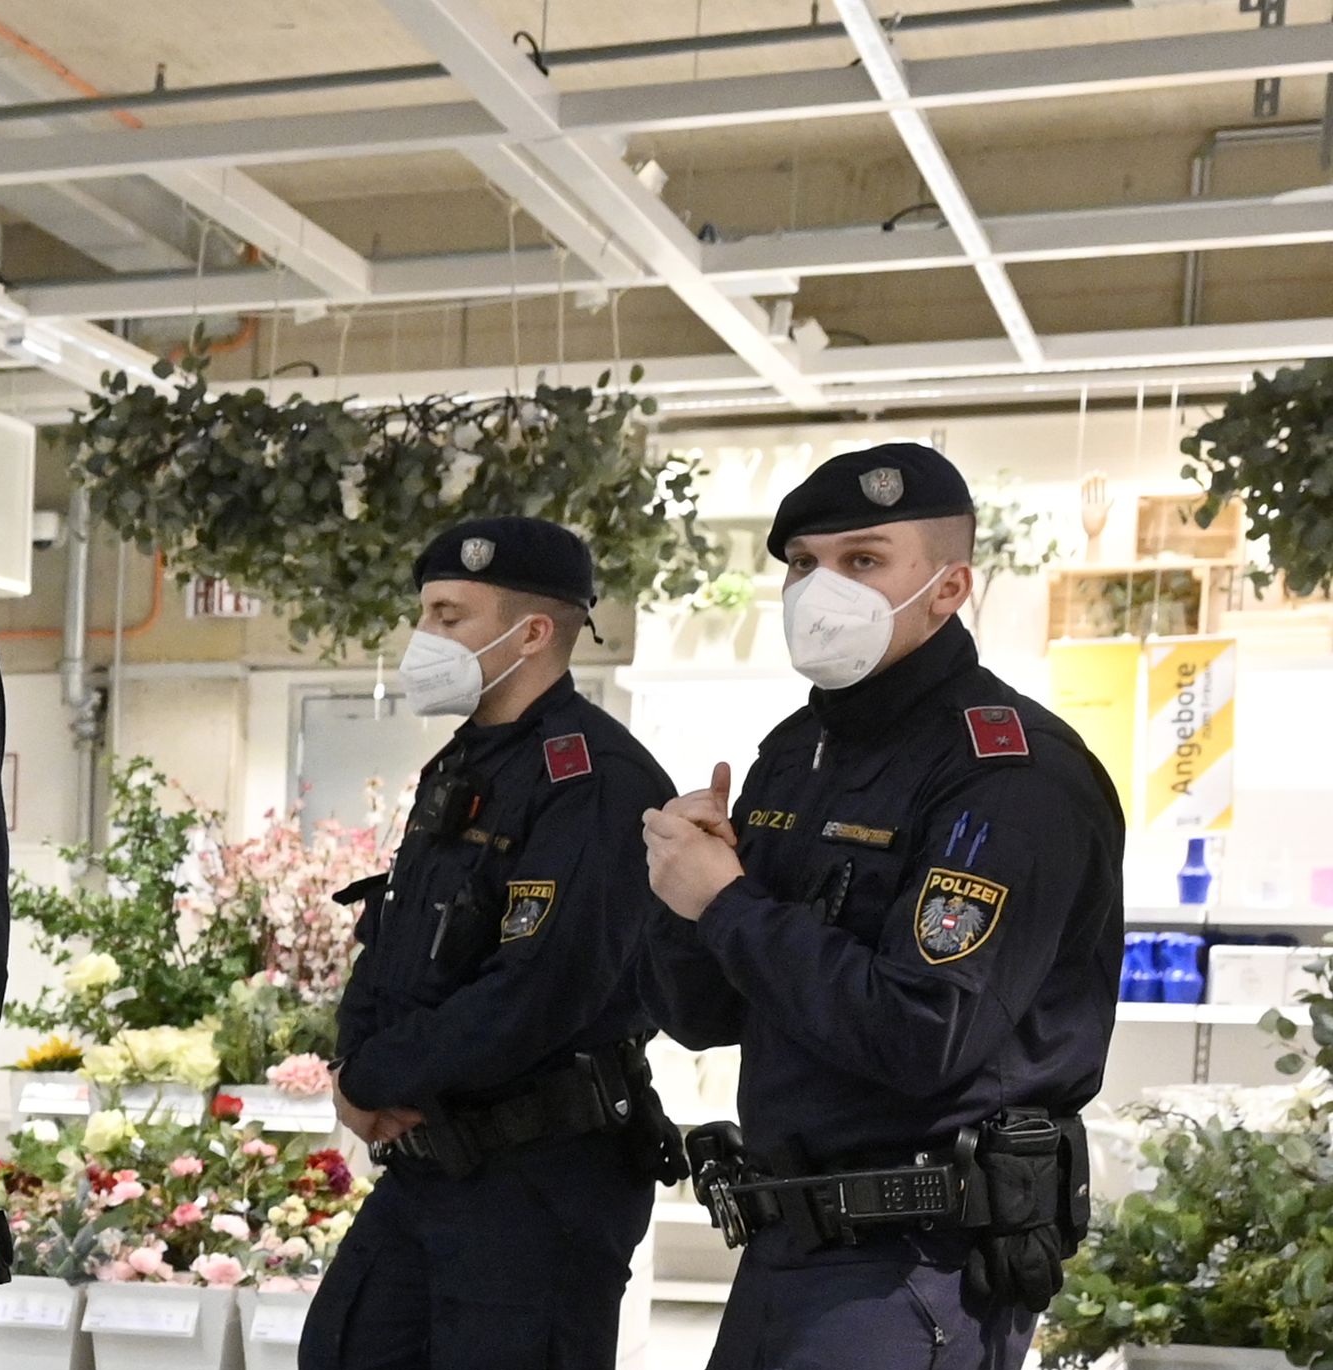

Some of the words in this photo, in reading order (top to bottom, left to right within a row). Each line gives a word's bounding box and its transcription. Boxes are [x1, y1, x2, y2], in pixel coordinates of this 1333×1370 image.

[1171, 660, 1202, 797] Angebote
[513, 885, 552, 899] POLIZEI
[929, 873, 999, 906] POLIZEI
